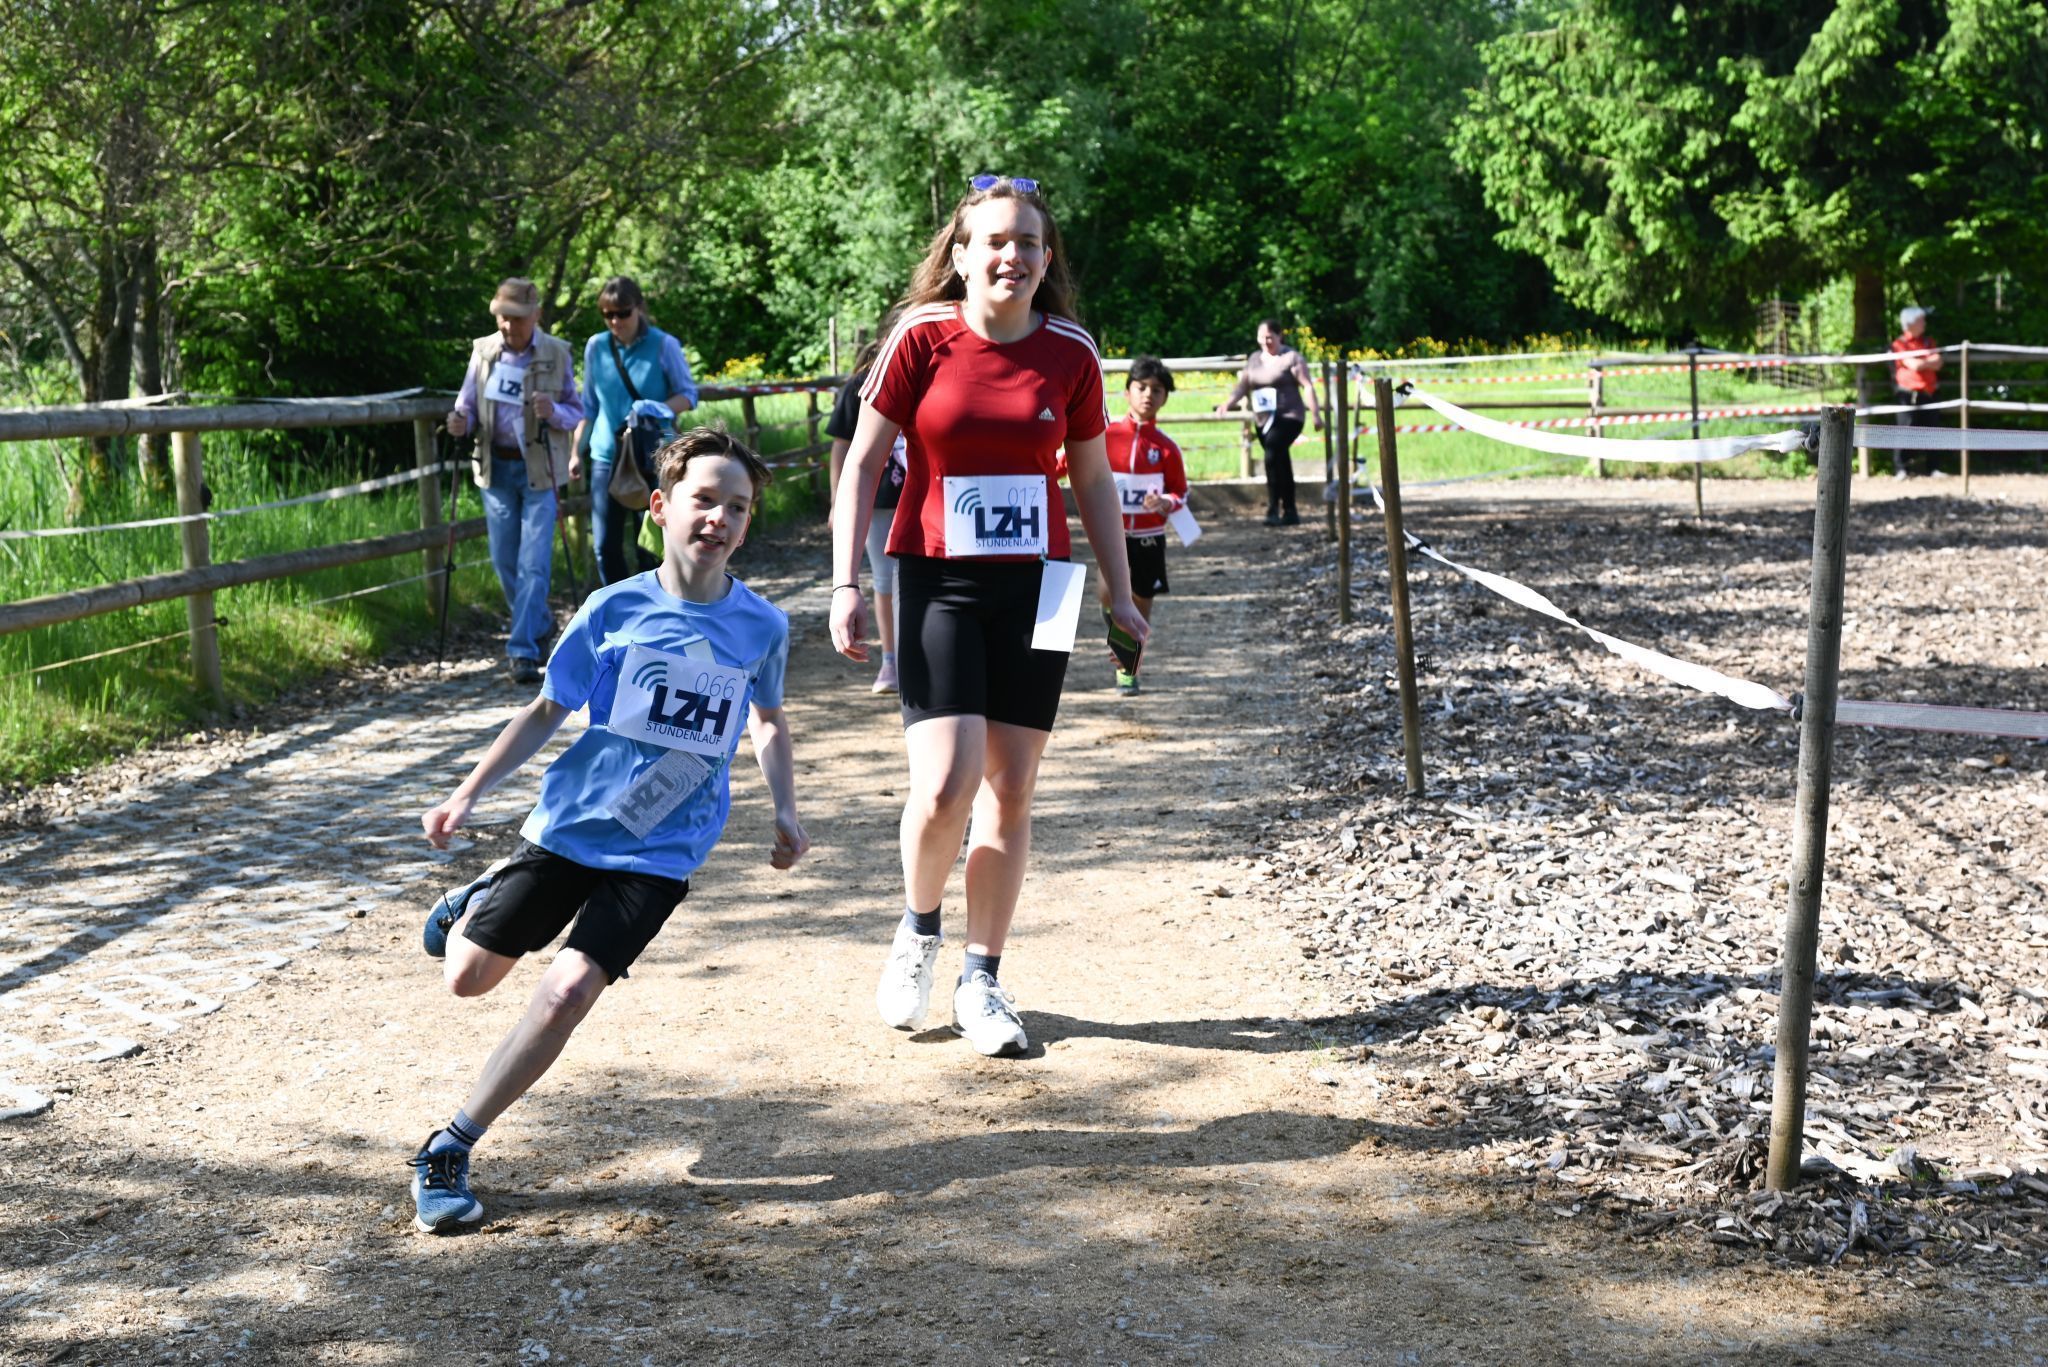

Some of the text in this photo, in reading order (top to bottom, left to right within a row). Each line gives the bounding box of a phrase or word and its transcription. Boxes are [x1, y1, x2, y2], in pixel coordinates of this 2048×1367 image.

[1007, 487, 1039, 507] 017
[975, 506, 1039, 538] LZH
[975, 537, 1039, 549] STUNDENLAUF
[694, 671, 737, 700] 066
[647, 684, 732, 737] LZH
[645, 720, 723, 746] STUNDENLAUF
[616, 769, 677, 822] LZH
